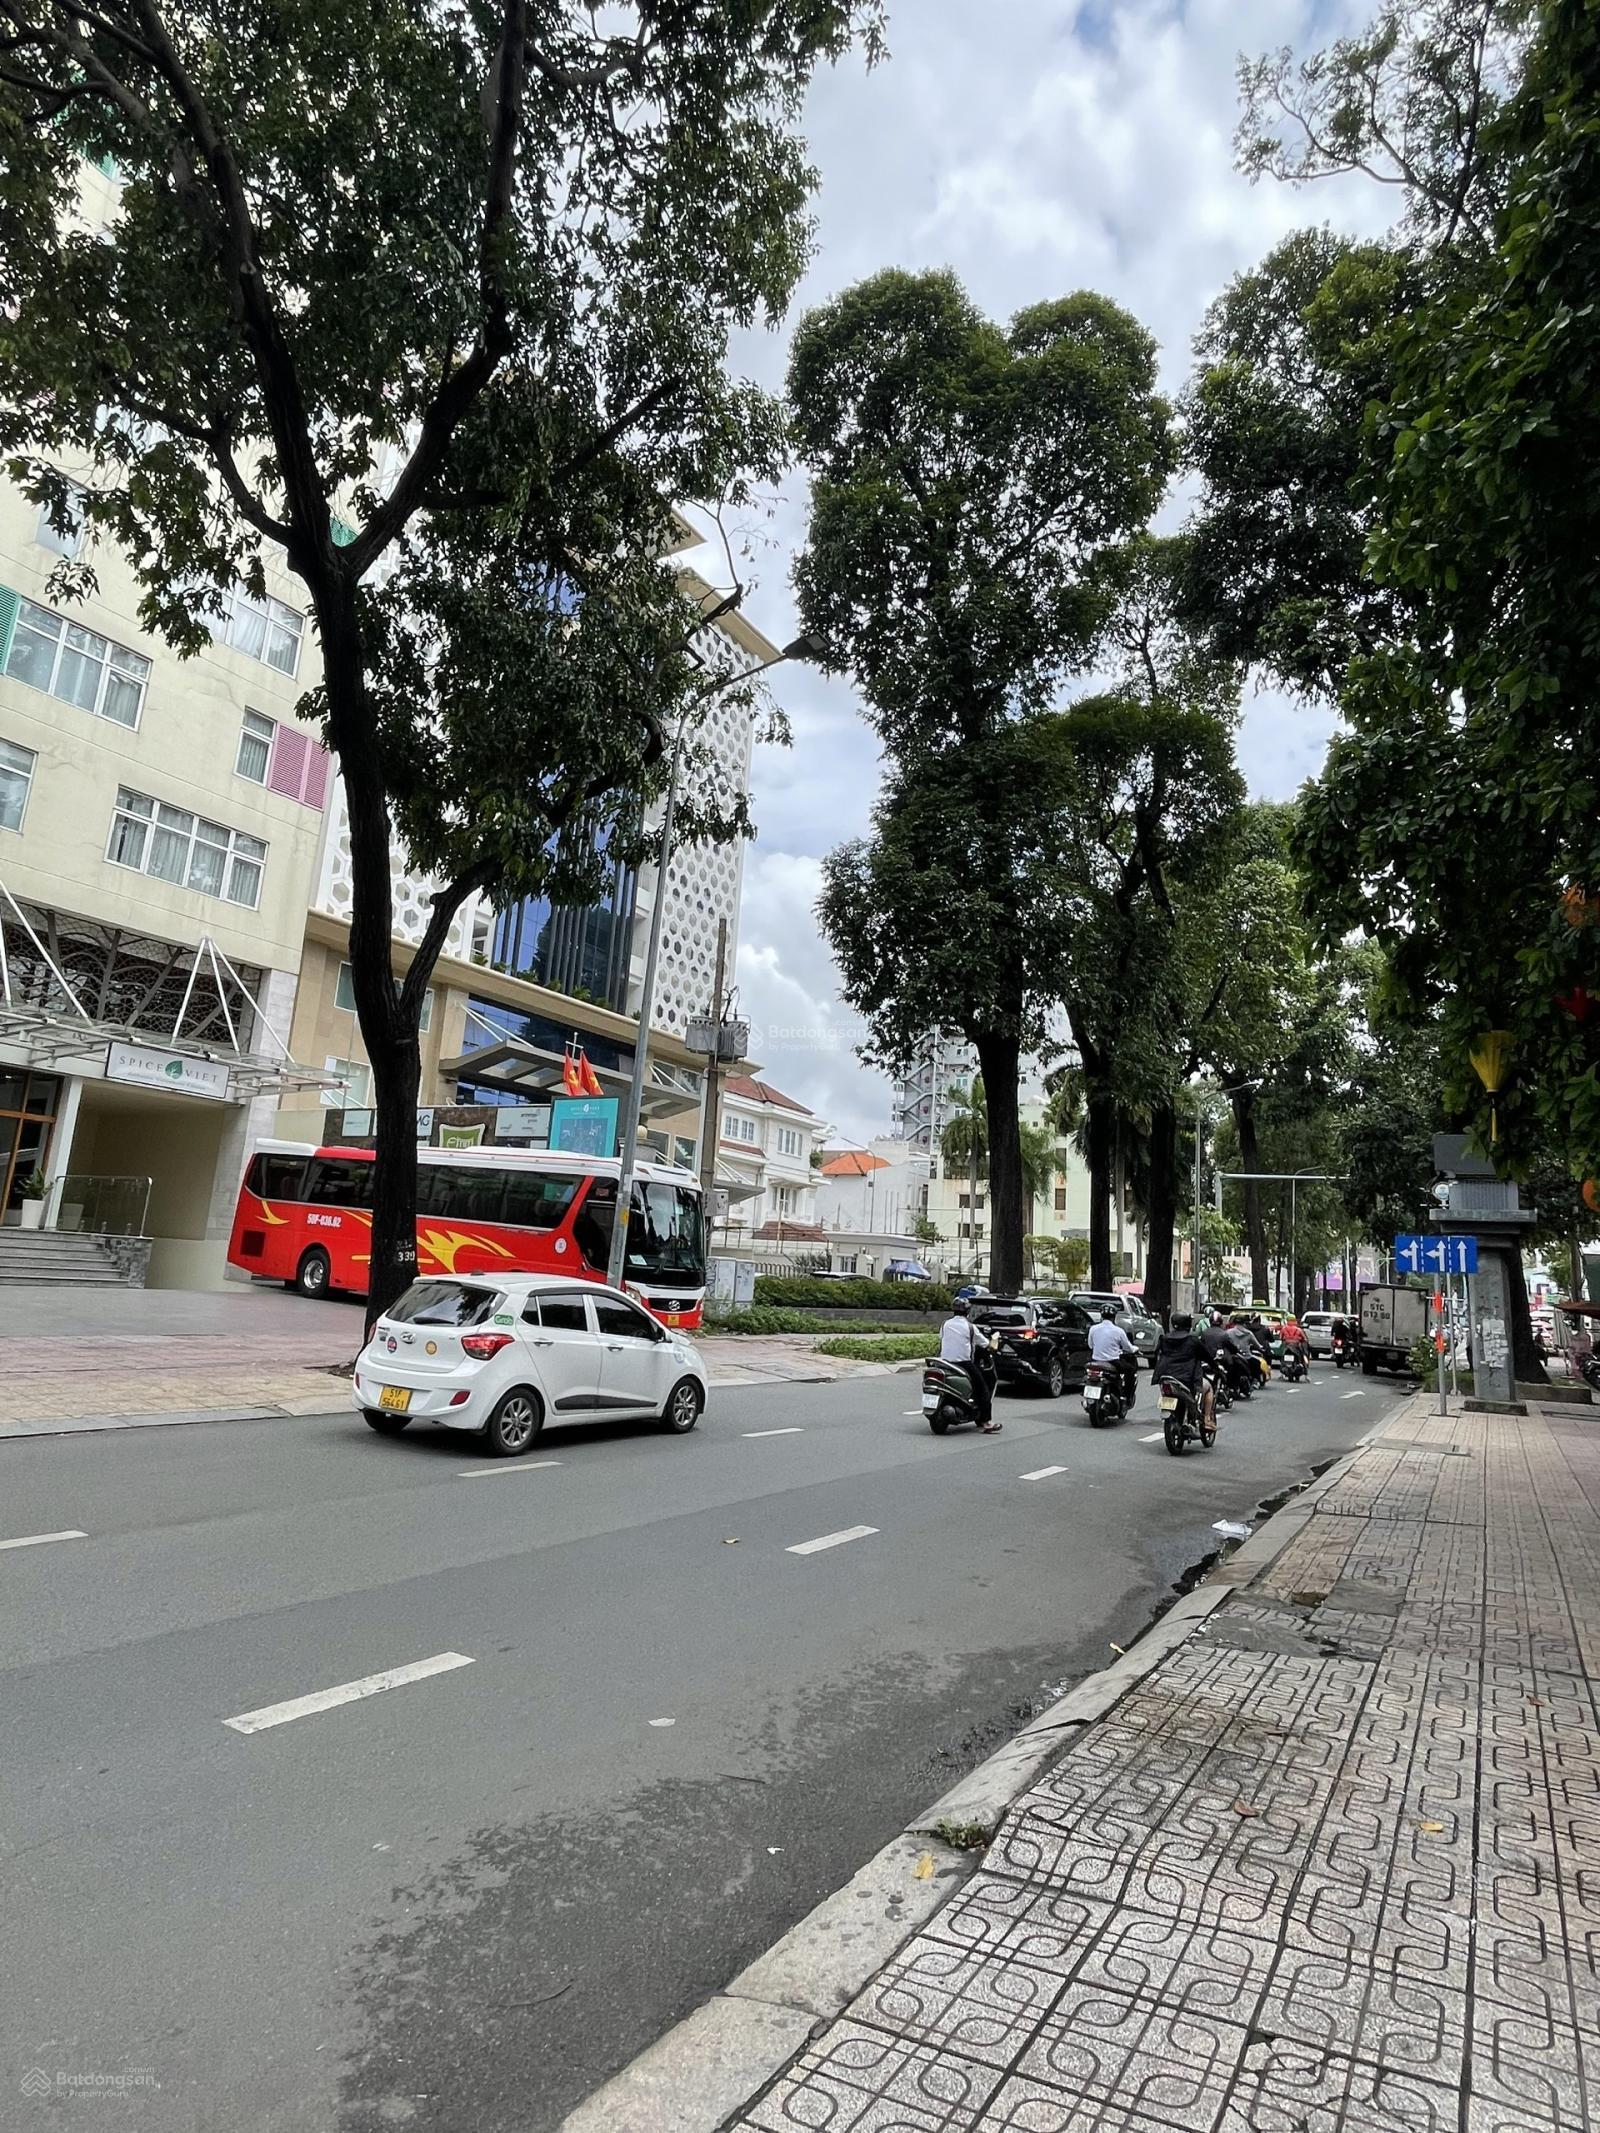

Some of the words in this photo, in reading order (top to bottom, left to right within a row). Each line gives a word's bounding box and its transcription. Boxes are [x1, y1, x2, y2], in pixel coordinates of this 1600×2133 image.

[119, 1055, 164, 1073] SPICE
[186, 1069, 217, 1084] VIET
[495, 1315, 513, 1326] Grab
